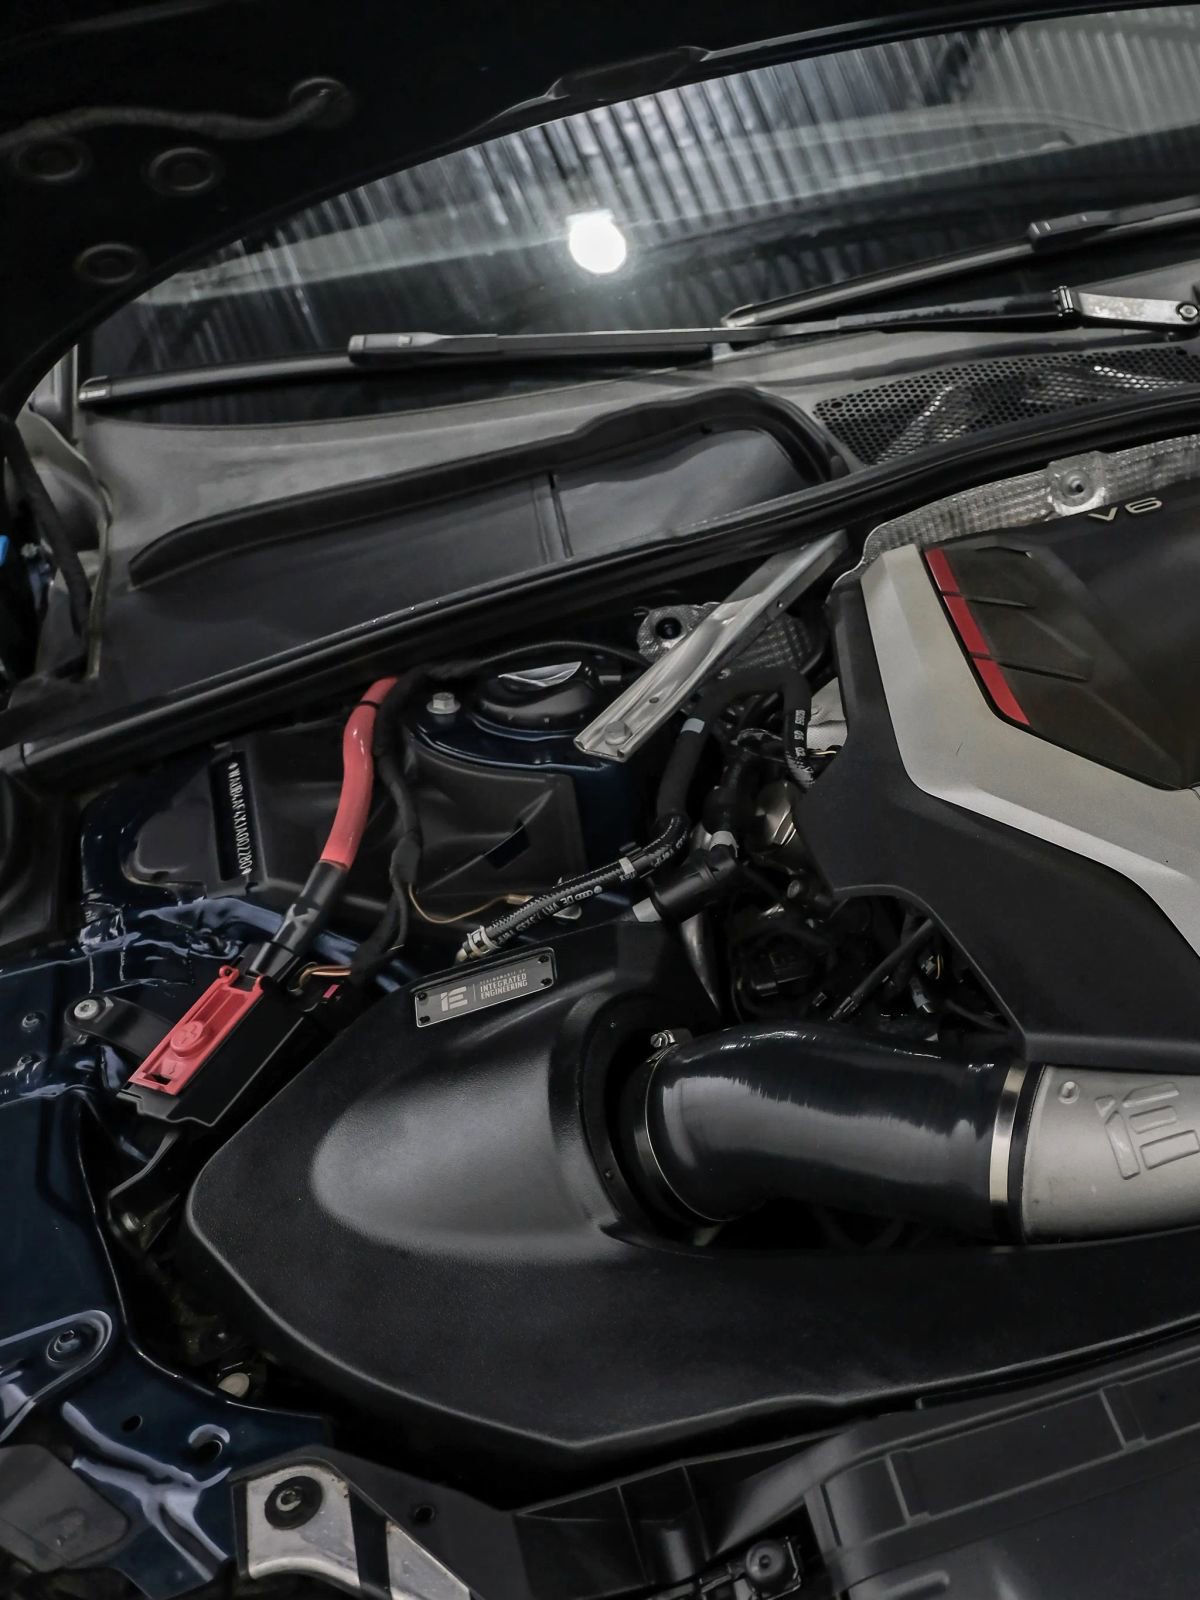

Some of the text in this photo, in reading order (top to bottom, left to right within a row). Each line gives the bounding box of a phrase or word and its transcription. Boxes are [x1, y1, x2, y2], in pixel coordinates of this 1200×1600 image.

[1088, 497, 1162, 521] V6
[480, 972, 527, 991] INTEGRATED
[480, 980, 528, 1000] ENGINEERING
